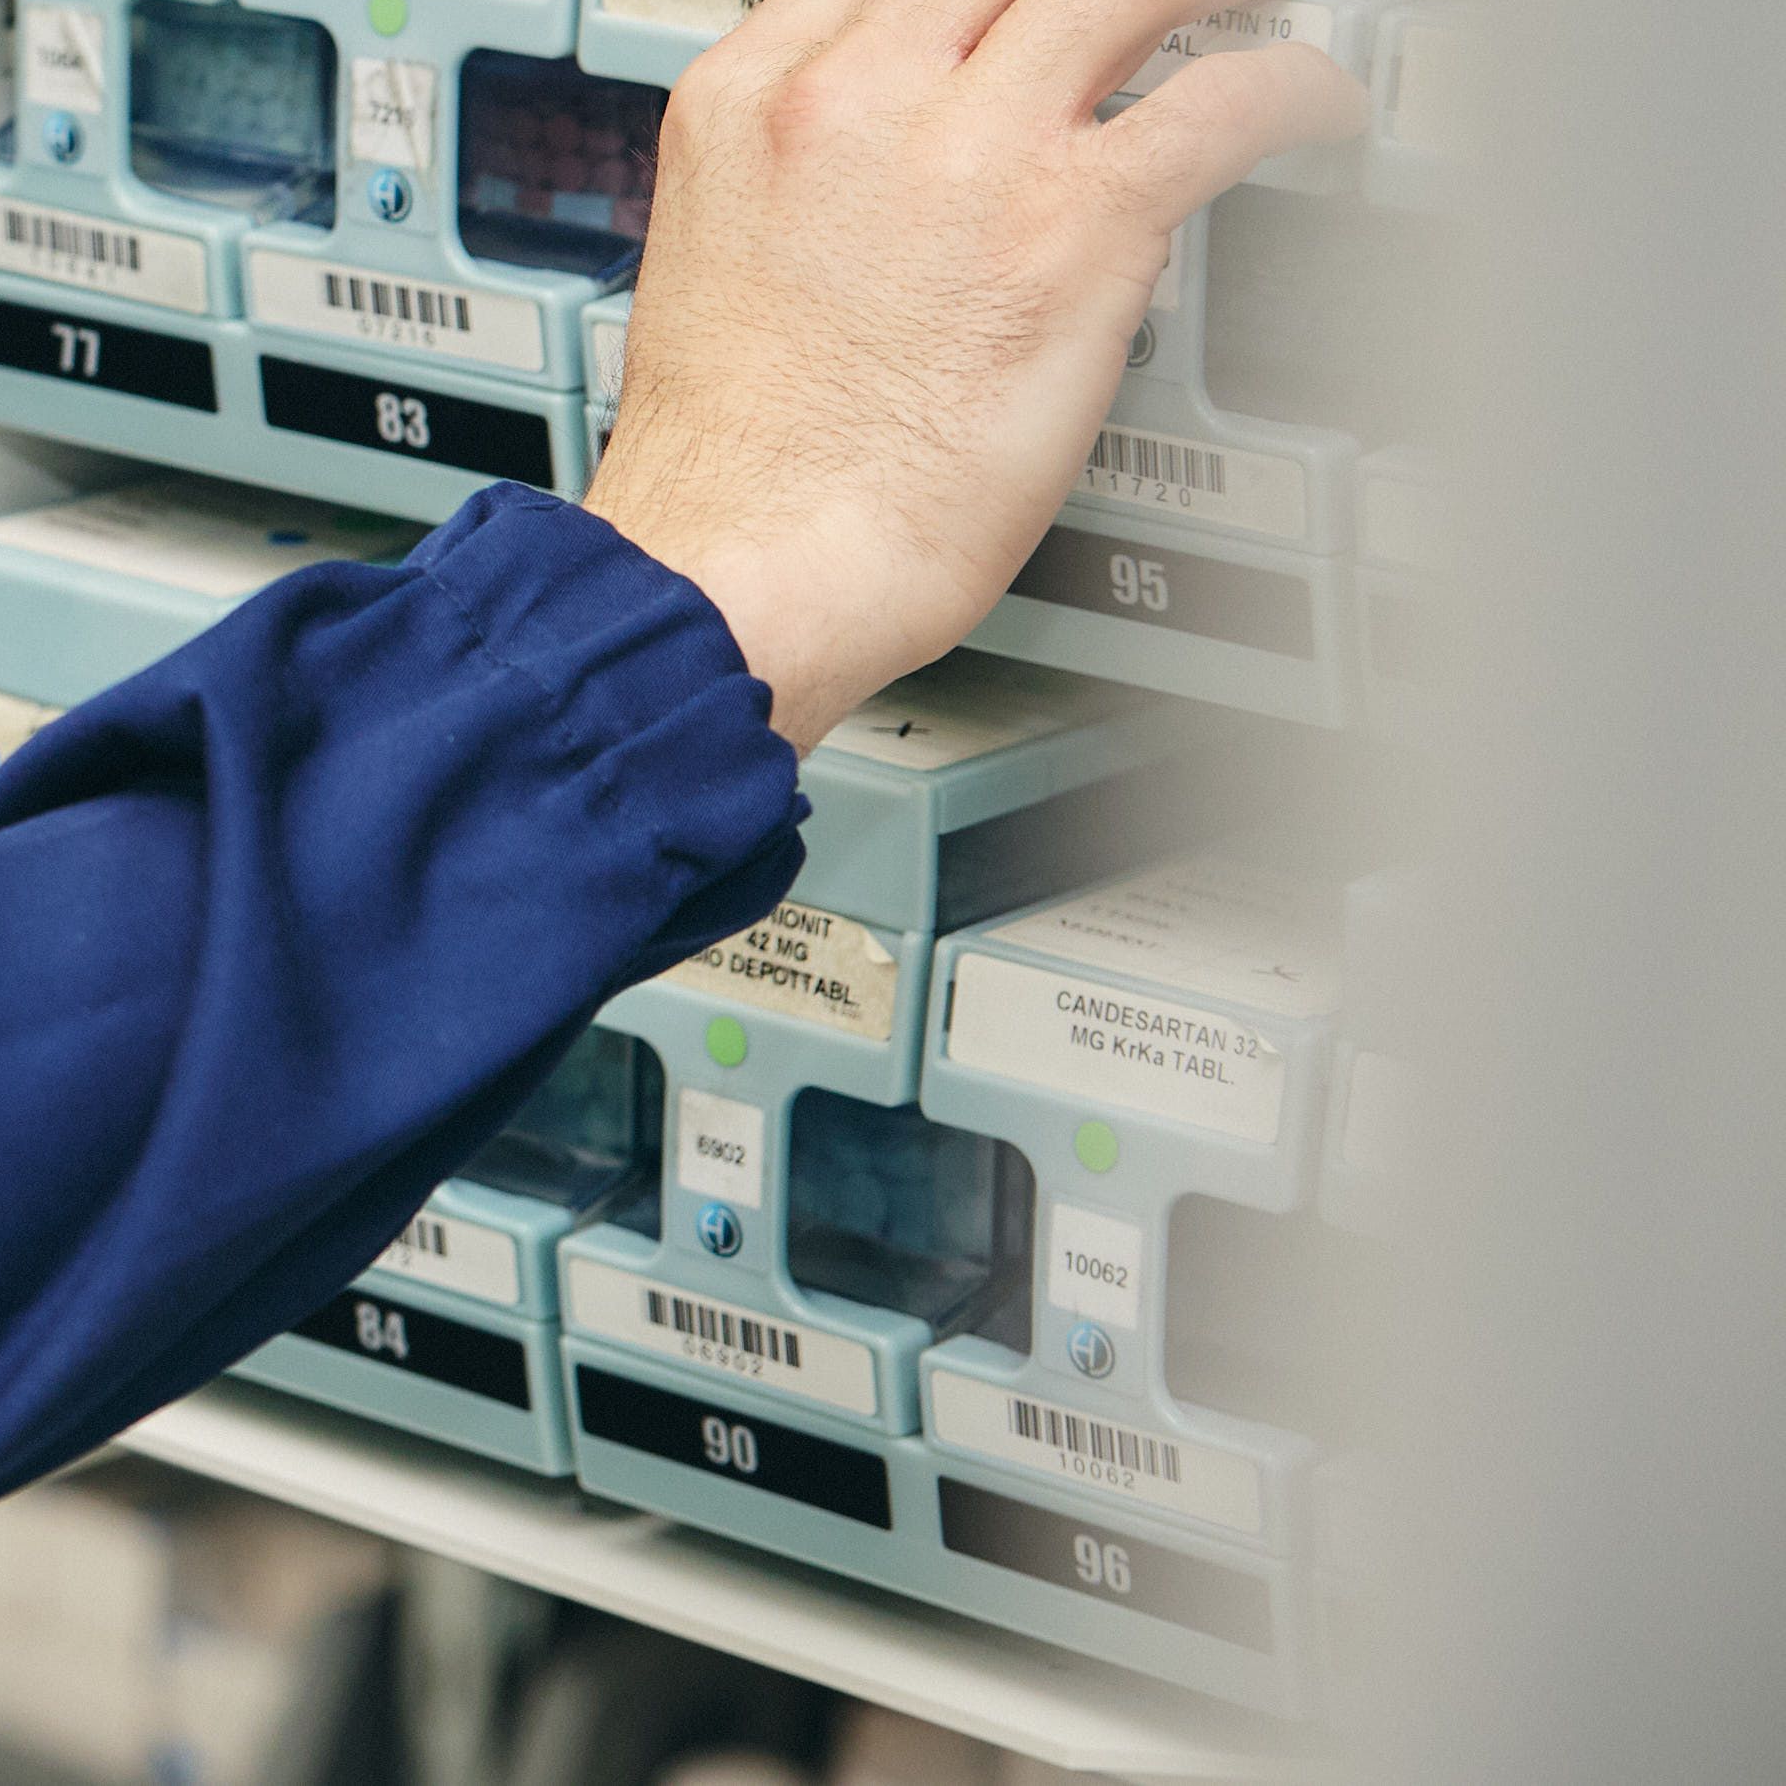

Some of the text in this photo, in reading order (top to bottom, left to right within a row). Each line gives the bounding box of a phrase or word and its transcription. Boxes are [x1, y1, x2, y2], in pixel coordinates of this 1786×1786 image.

[1160, 32, 1204, 58] AL.
[1196, 8, 1292, 39] ATIN 10
[50, 323, 101, 378] 77
[375, 392, 429, 449] 83
[1085, 468, 1192, 508] 11720
[1109, 552, 1170, 612] 95
[747, 930, 809, 962] 42 MG
[1056, 989, 1259, 1060] CANDESARTAN 32
[1070, 1024, 1236, 1086] MG KrKa TABL.
[697, 1134, 747, 1168] 6902
[1064, 1250, 1129, 1289] 10062
[353, 1300, 411, 1360] 84
[702, 1415, 759, 1474] 90
[1059, 1452, 1136, 1490] 10062
[1073, 1533, 1132, 1595] 96
